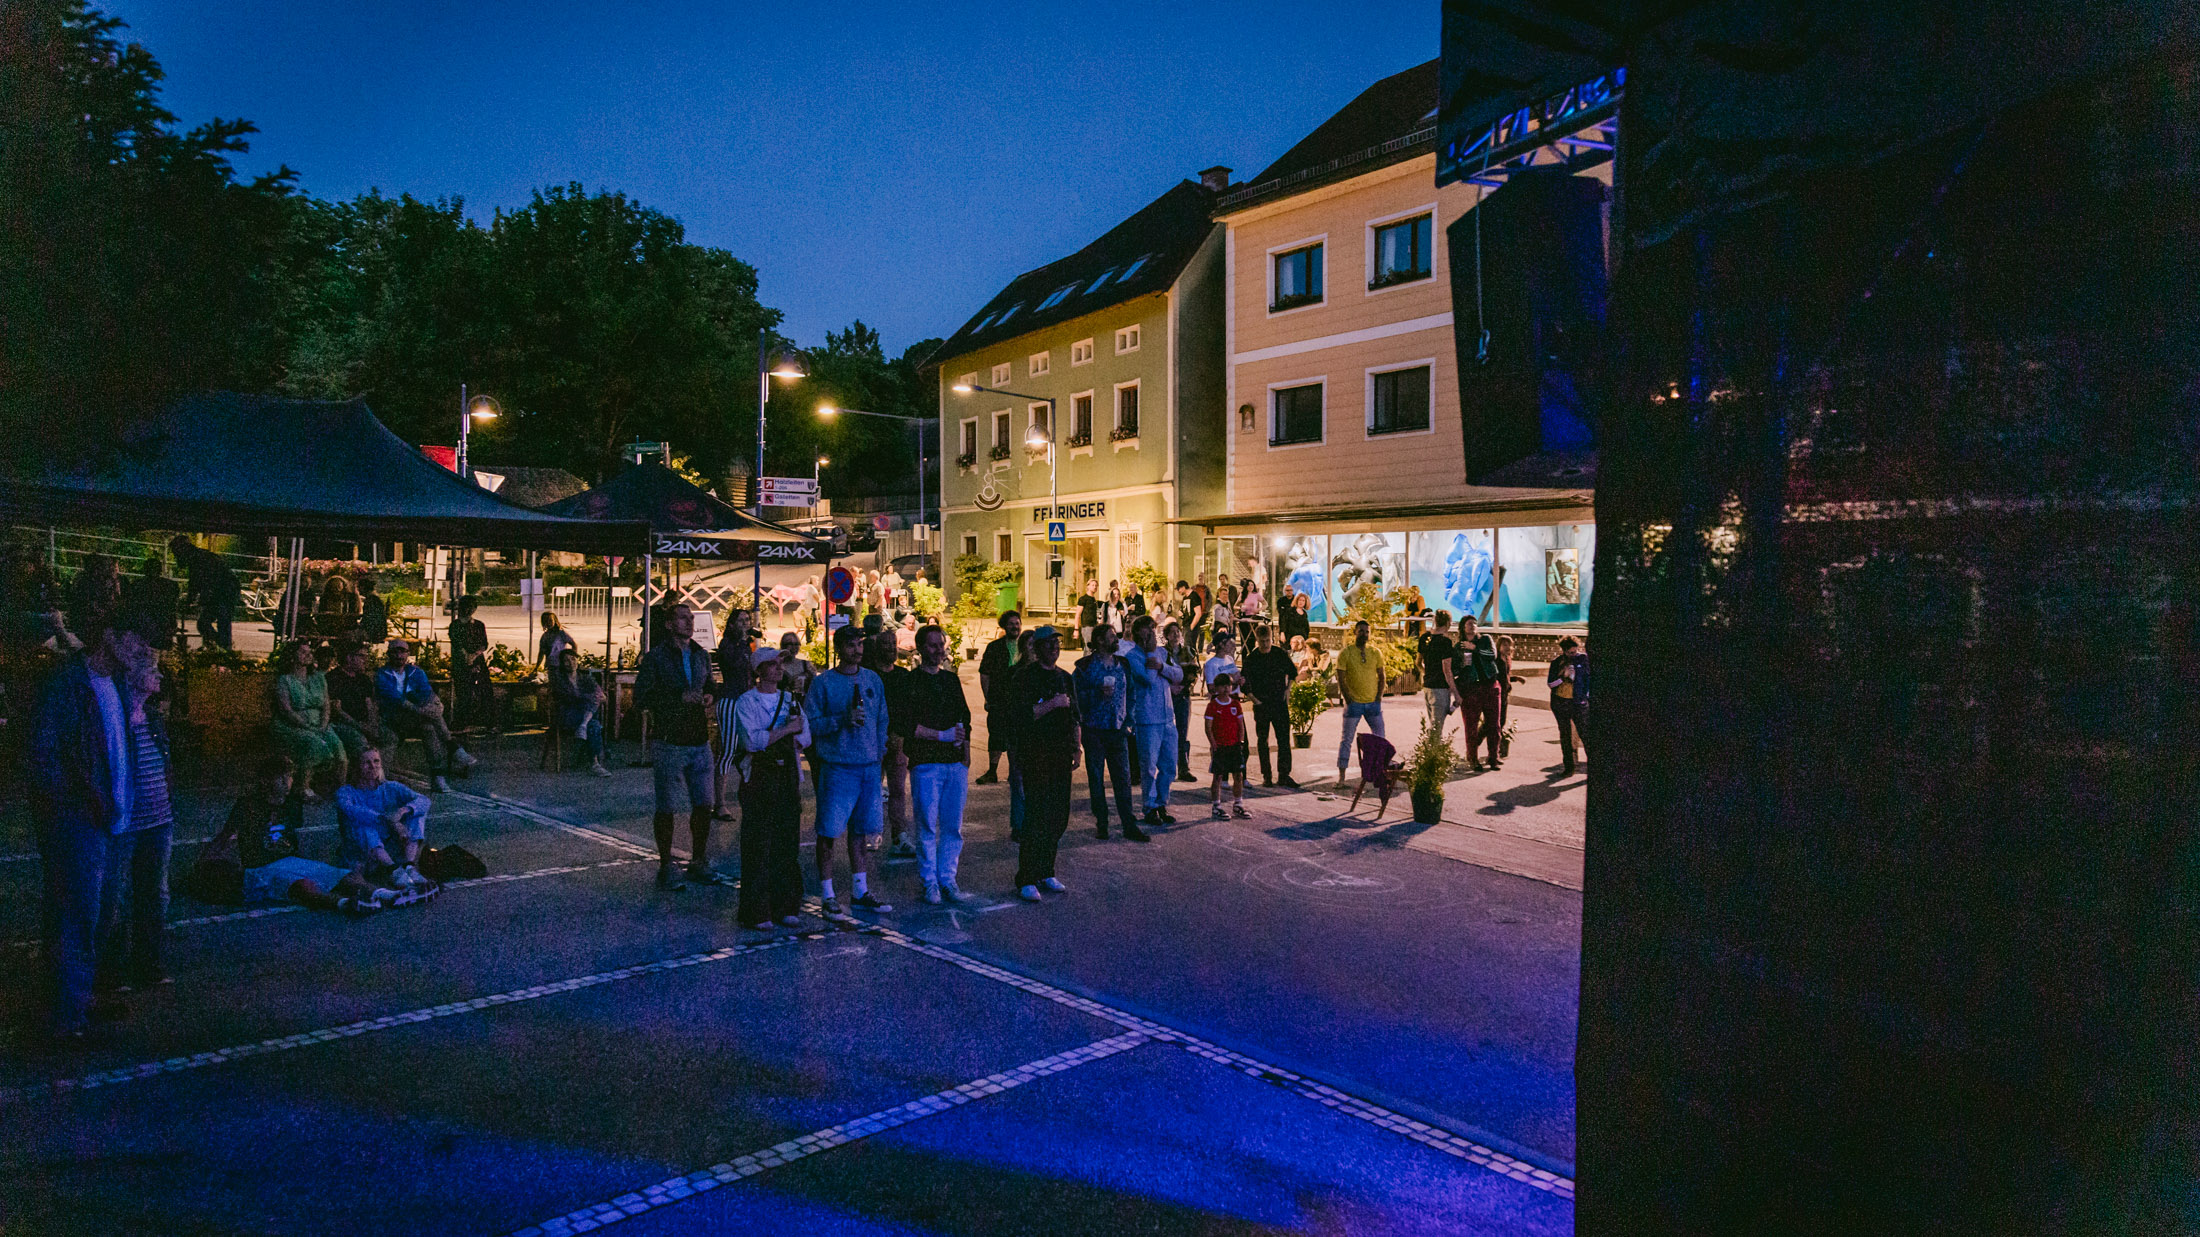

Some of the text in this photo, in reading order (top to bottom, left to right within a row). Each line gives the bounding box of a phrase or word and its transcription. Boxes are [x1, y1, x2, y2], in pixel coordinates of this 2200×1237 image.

[1033, 502, 1105, 521] FEHRINGER
[656, 540, 722, 555] 24MX
[757, 544, 816, 559] 24MX
